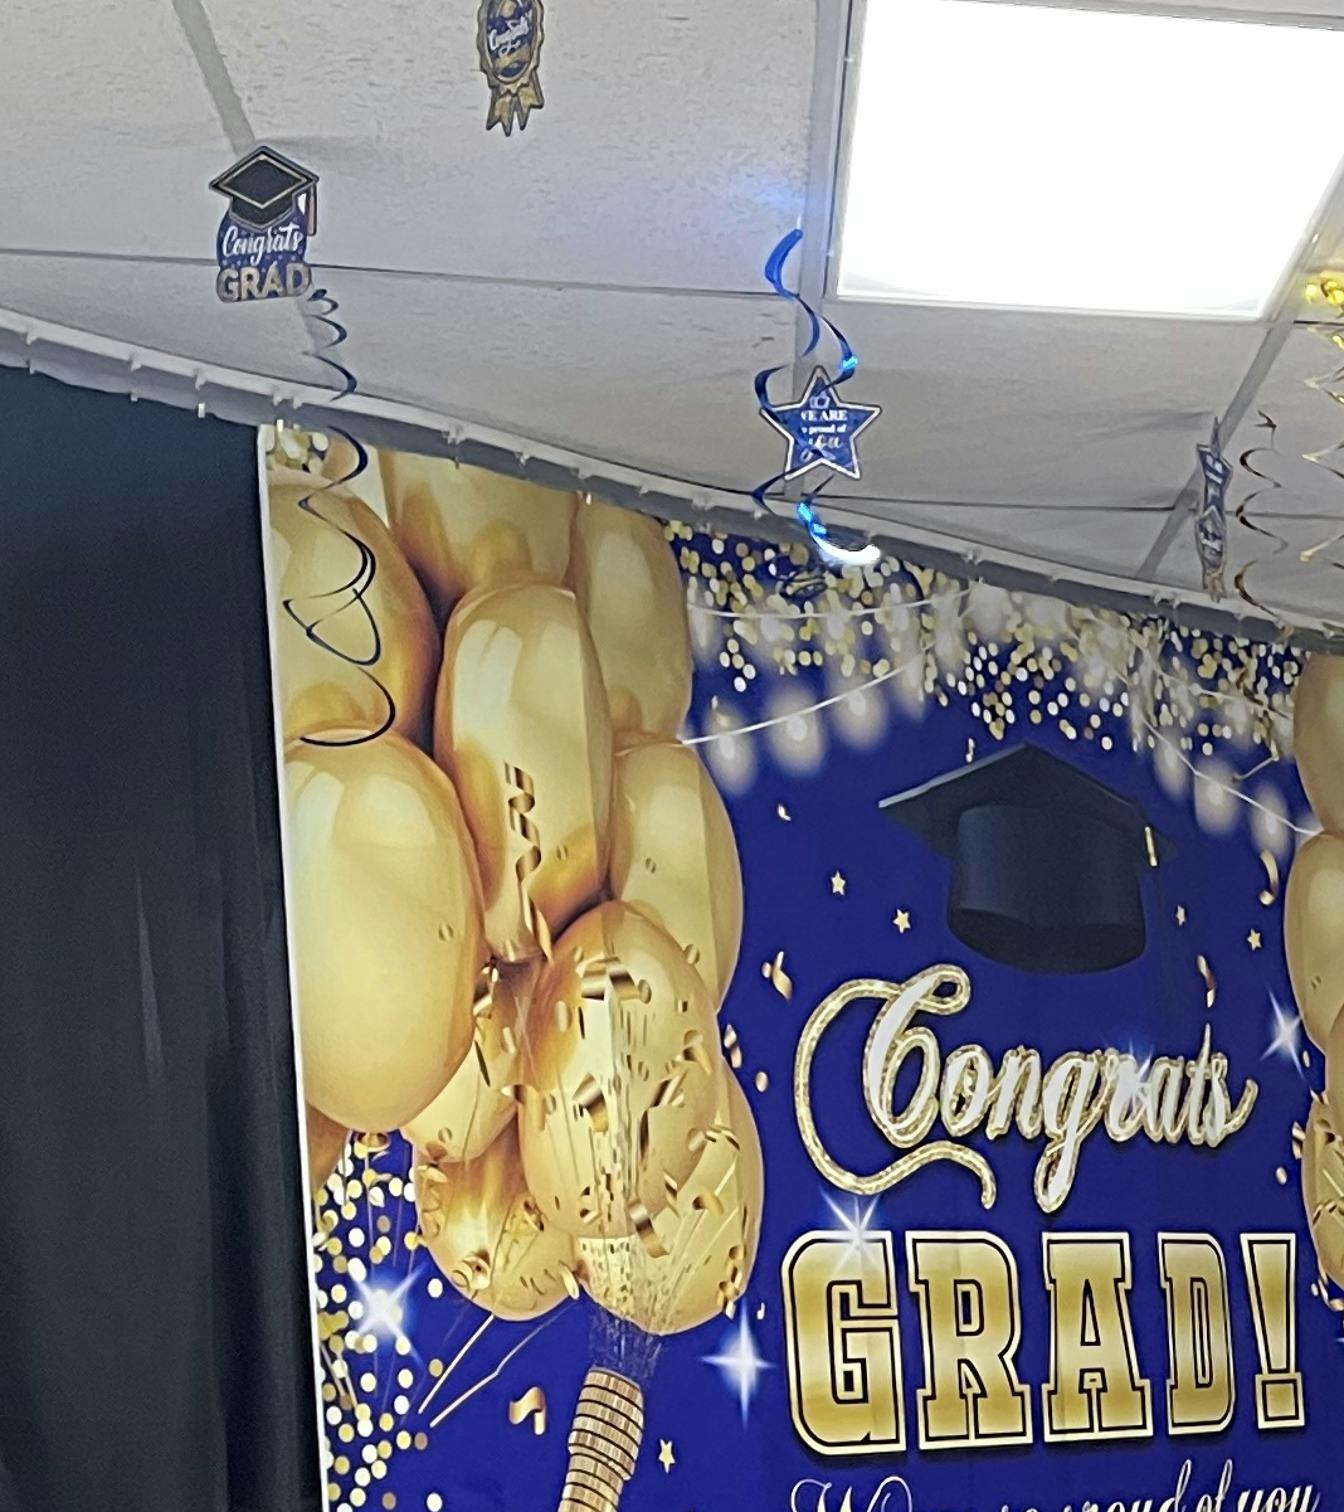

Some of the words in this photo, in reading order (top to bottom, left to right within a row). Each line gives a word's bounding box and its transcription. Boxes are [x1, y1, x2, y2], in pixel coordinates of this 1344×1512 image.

[222, 223, 304, 266] Congrats
[216, 261, 312, 302] GRAD
[820, 410, 848, 421] ARE
[837, 424, 848, 433] of
[795, 962, 1258, 1214] Congrats
[781, 1230, 1307, 1457] GRAD!
